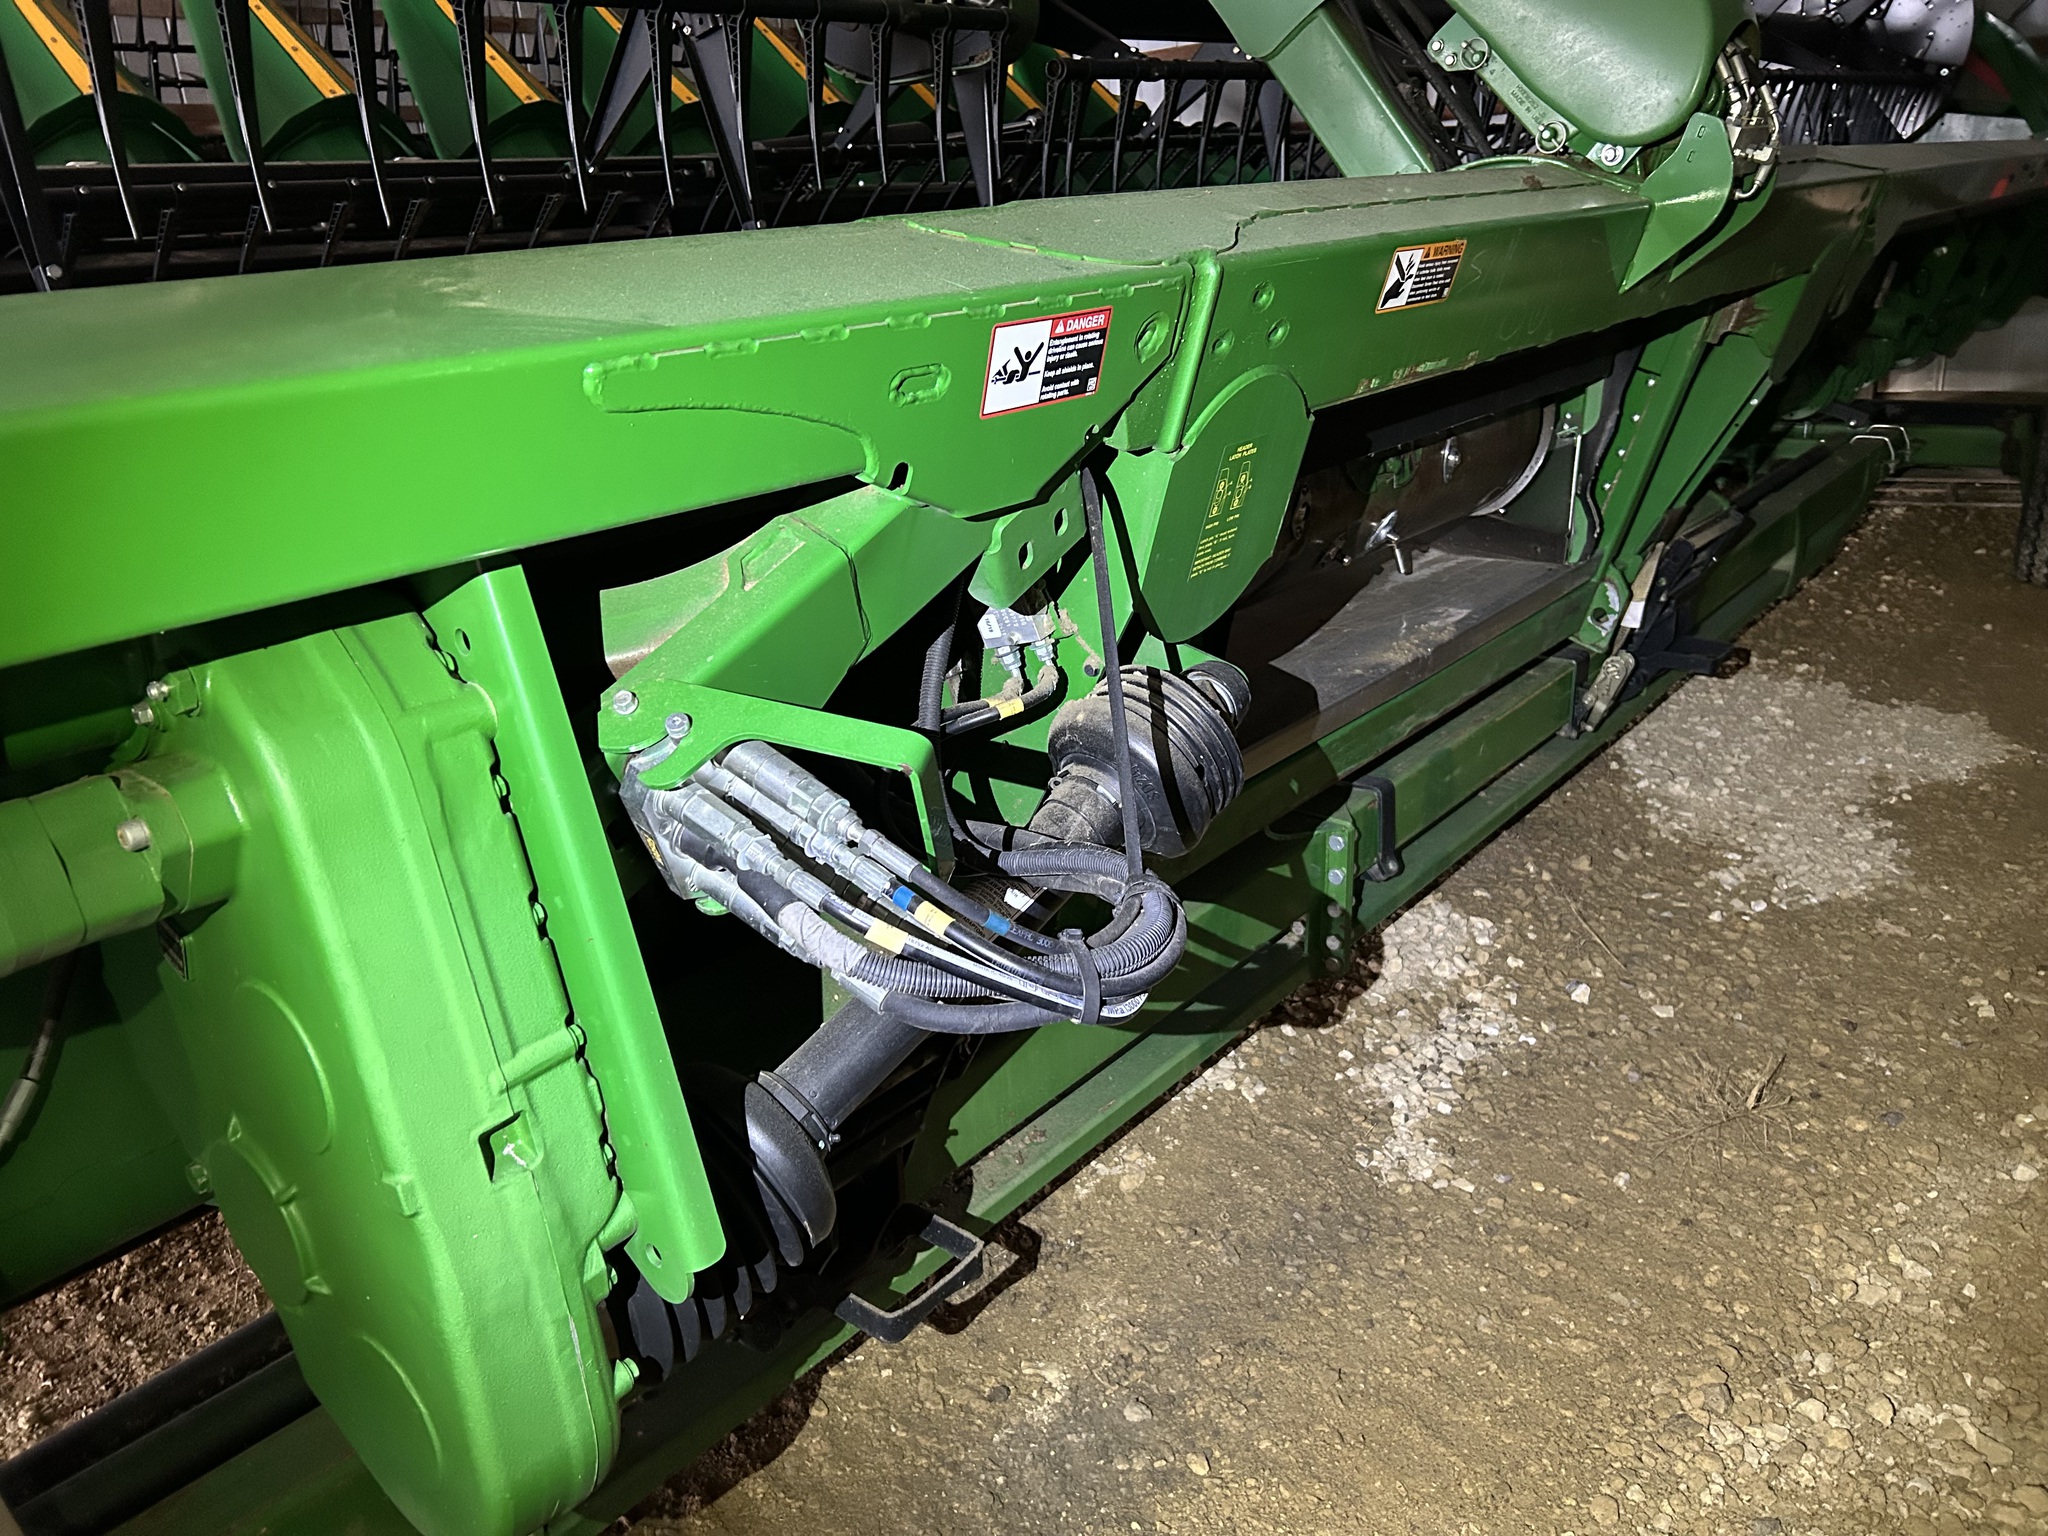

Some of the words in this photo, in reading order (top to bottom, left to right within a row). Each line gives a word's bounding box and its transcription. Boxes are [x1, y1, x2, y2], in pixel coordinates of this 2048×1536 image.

[1432, 242, 1464, 258] WARNING
[1066, 314, 1105, 332] DANGER
[1084, 332, 1100, 340] rotating
[1046, 354, 1060, 363] injury
[1044, 370, 1056, 378] Keep
[1062, 364, 1076, 374] shields
[1041, 384, 1054, 392] Avoid
[1054, 380, 1070, 390] contact
[1070, 378, 1080, 387] with
[1040, 392, 1056, 400] rotating
